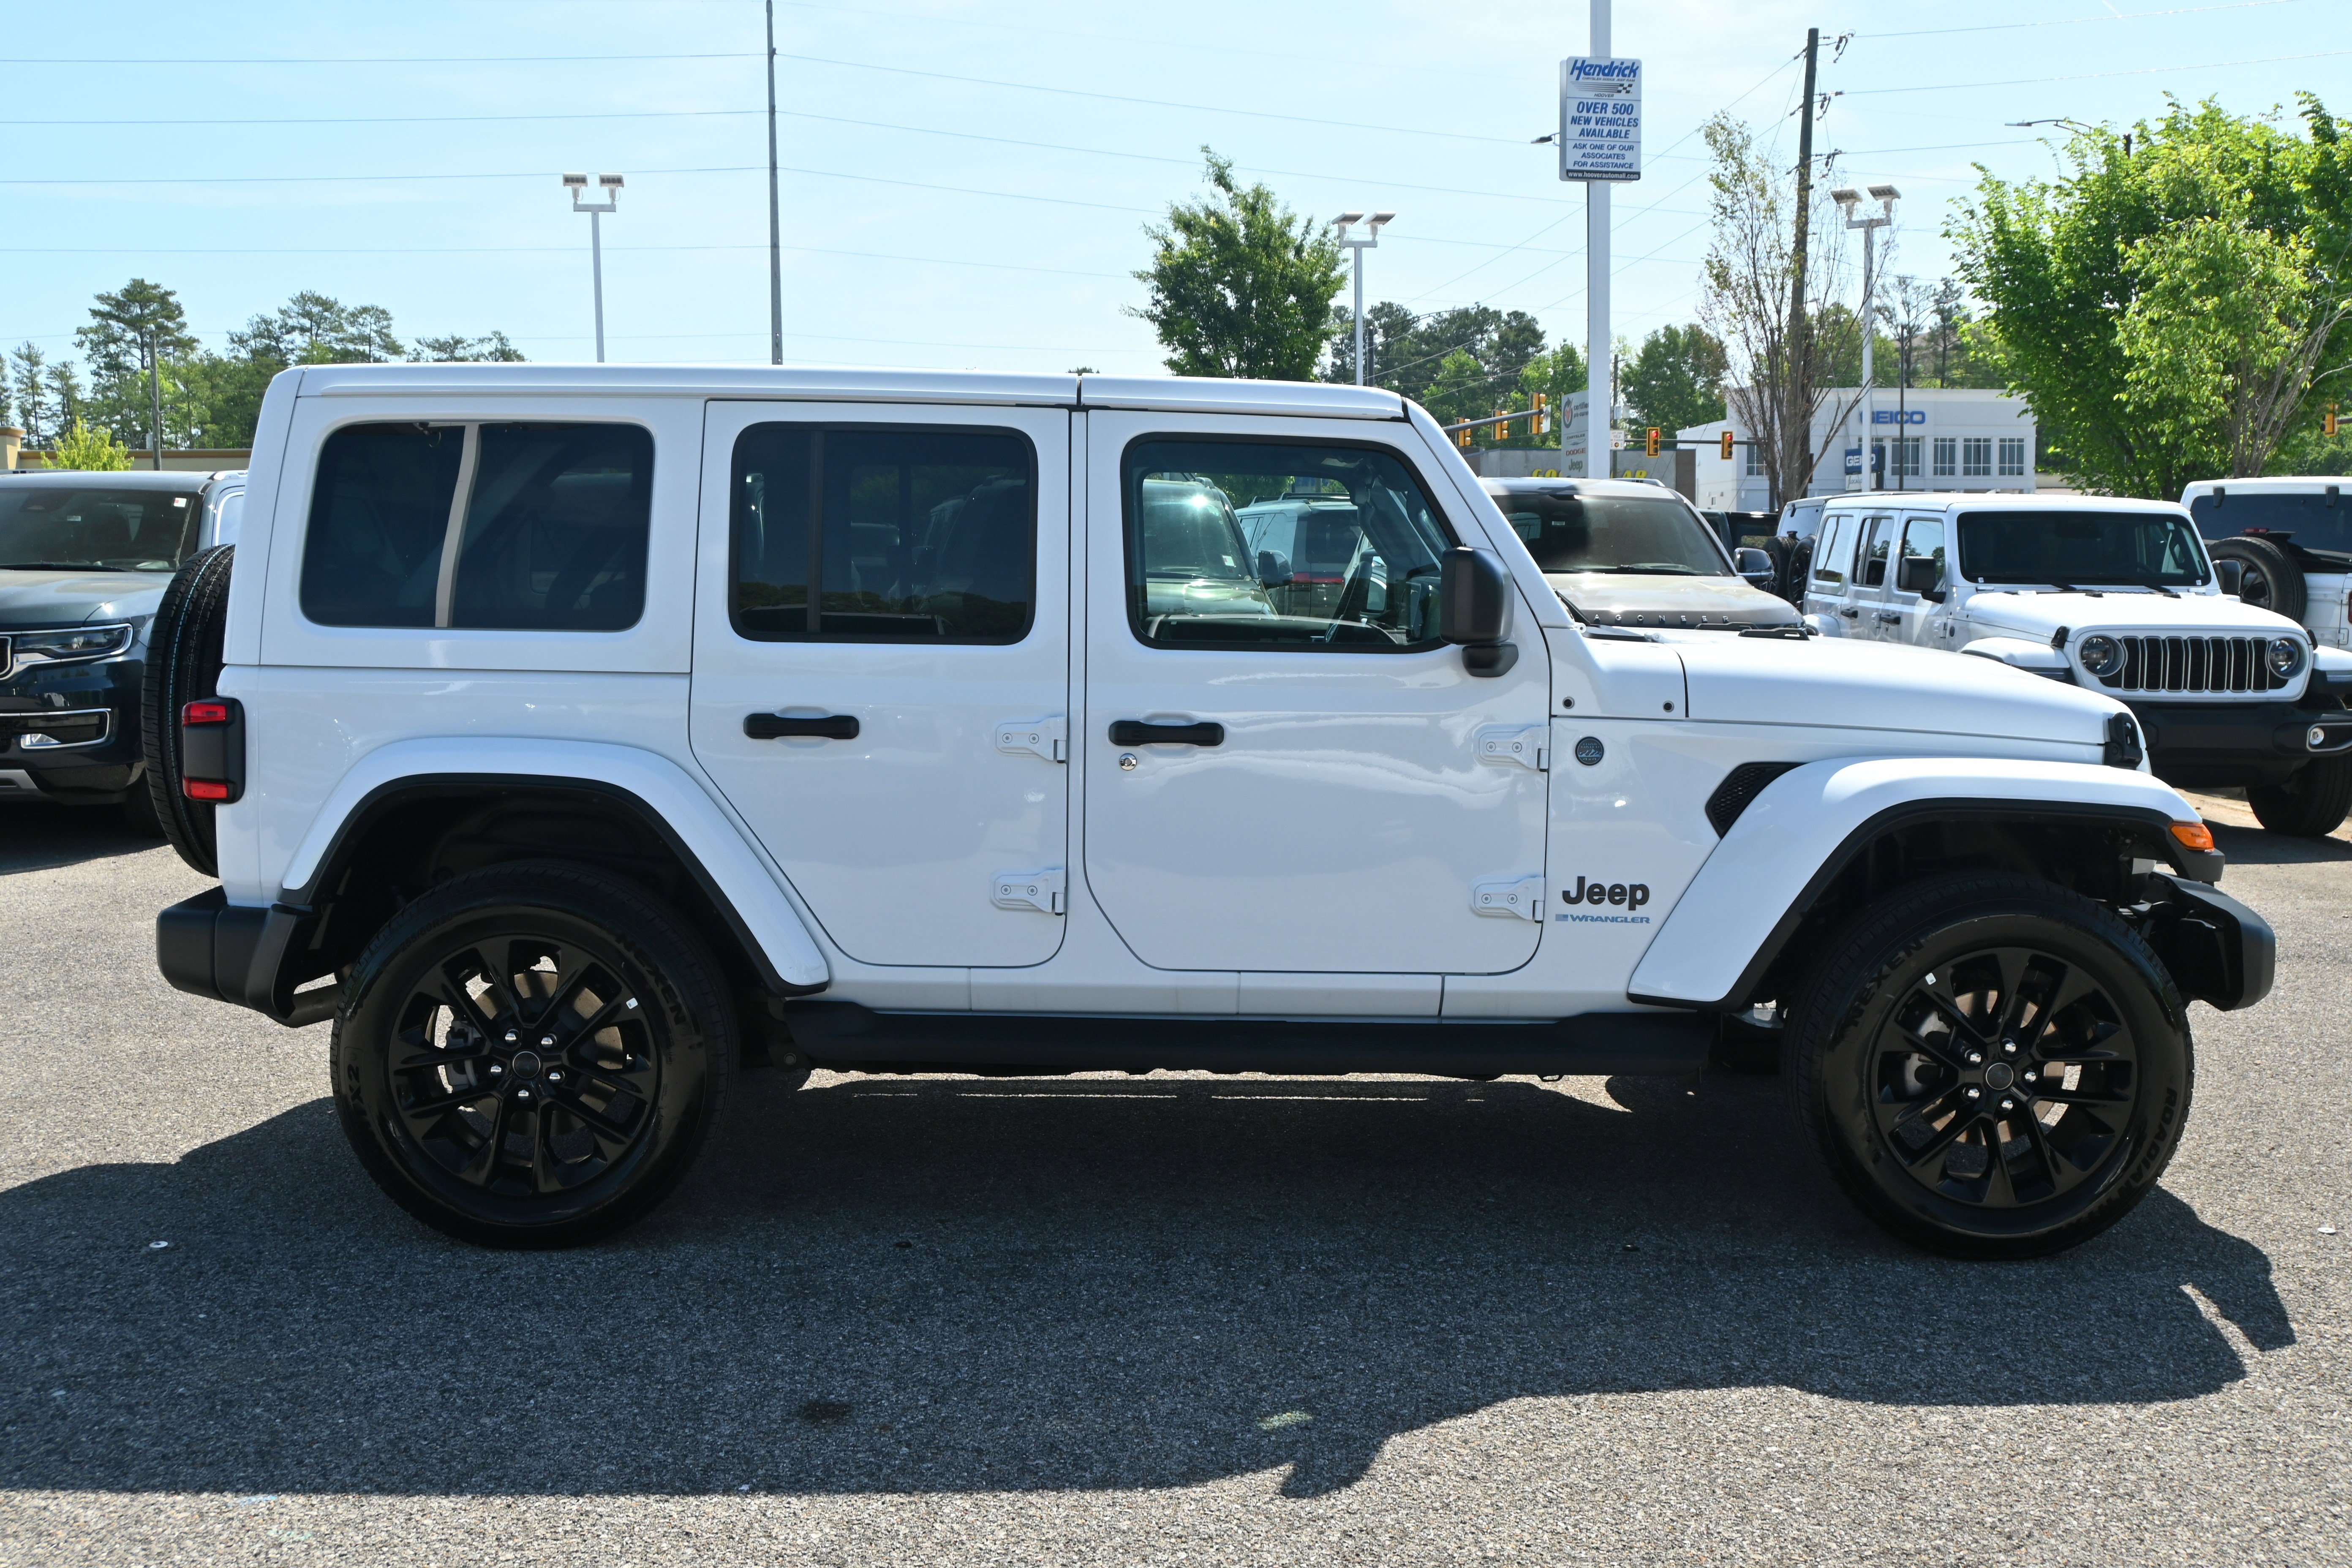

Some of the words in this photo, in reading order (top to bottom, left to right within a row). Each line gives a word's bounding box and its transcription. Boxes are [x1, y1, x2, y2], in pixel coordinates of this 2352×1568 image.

[1570, 59, 1639, 81] Hendrick
[1576, 101, 1609, 114] OVER
[1612, 103, 1634, 115] 500
[1571, 115, 1592, 125] NEW
[1595, 116, 1639, 127] VEHICLES
[1579, 128, 1630, 139] AVAILABLE
[1566, 447, 1586, 456] DODGE
[1568, 459, 1583, 472] Jeep
[1846, 454, 1876, 466] GEIO
[1594, 614, 1729, 622] AGONEER
[1562, 876, 1650, 911] Jeep
[1570, 914, 1650, 923] WRANGLER
[2117, 1087, 2178, 1199] ROADIAN
